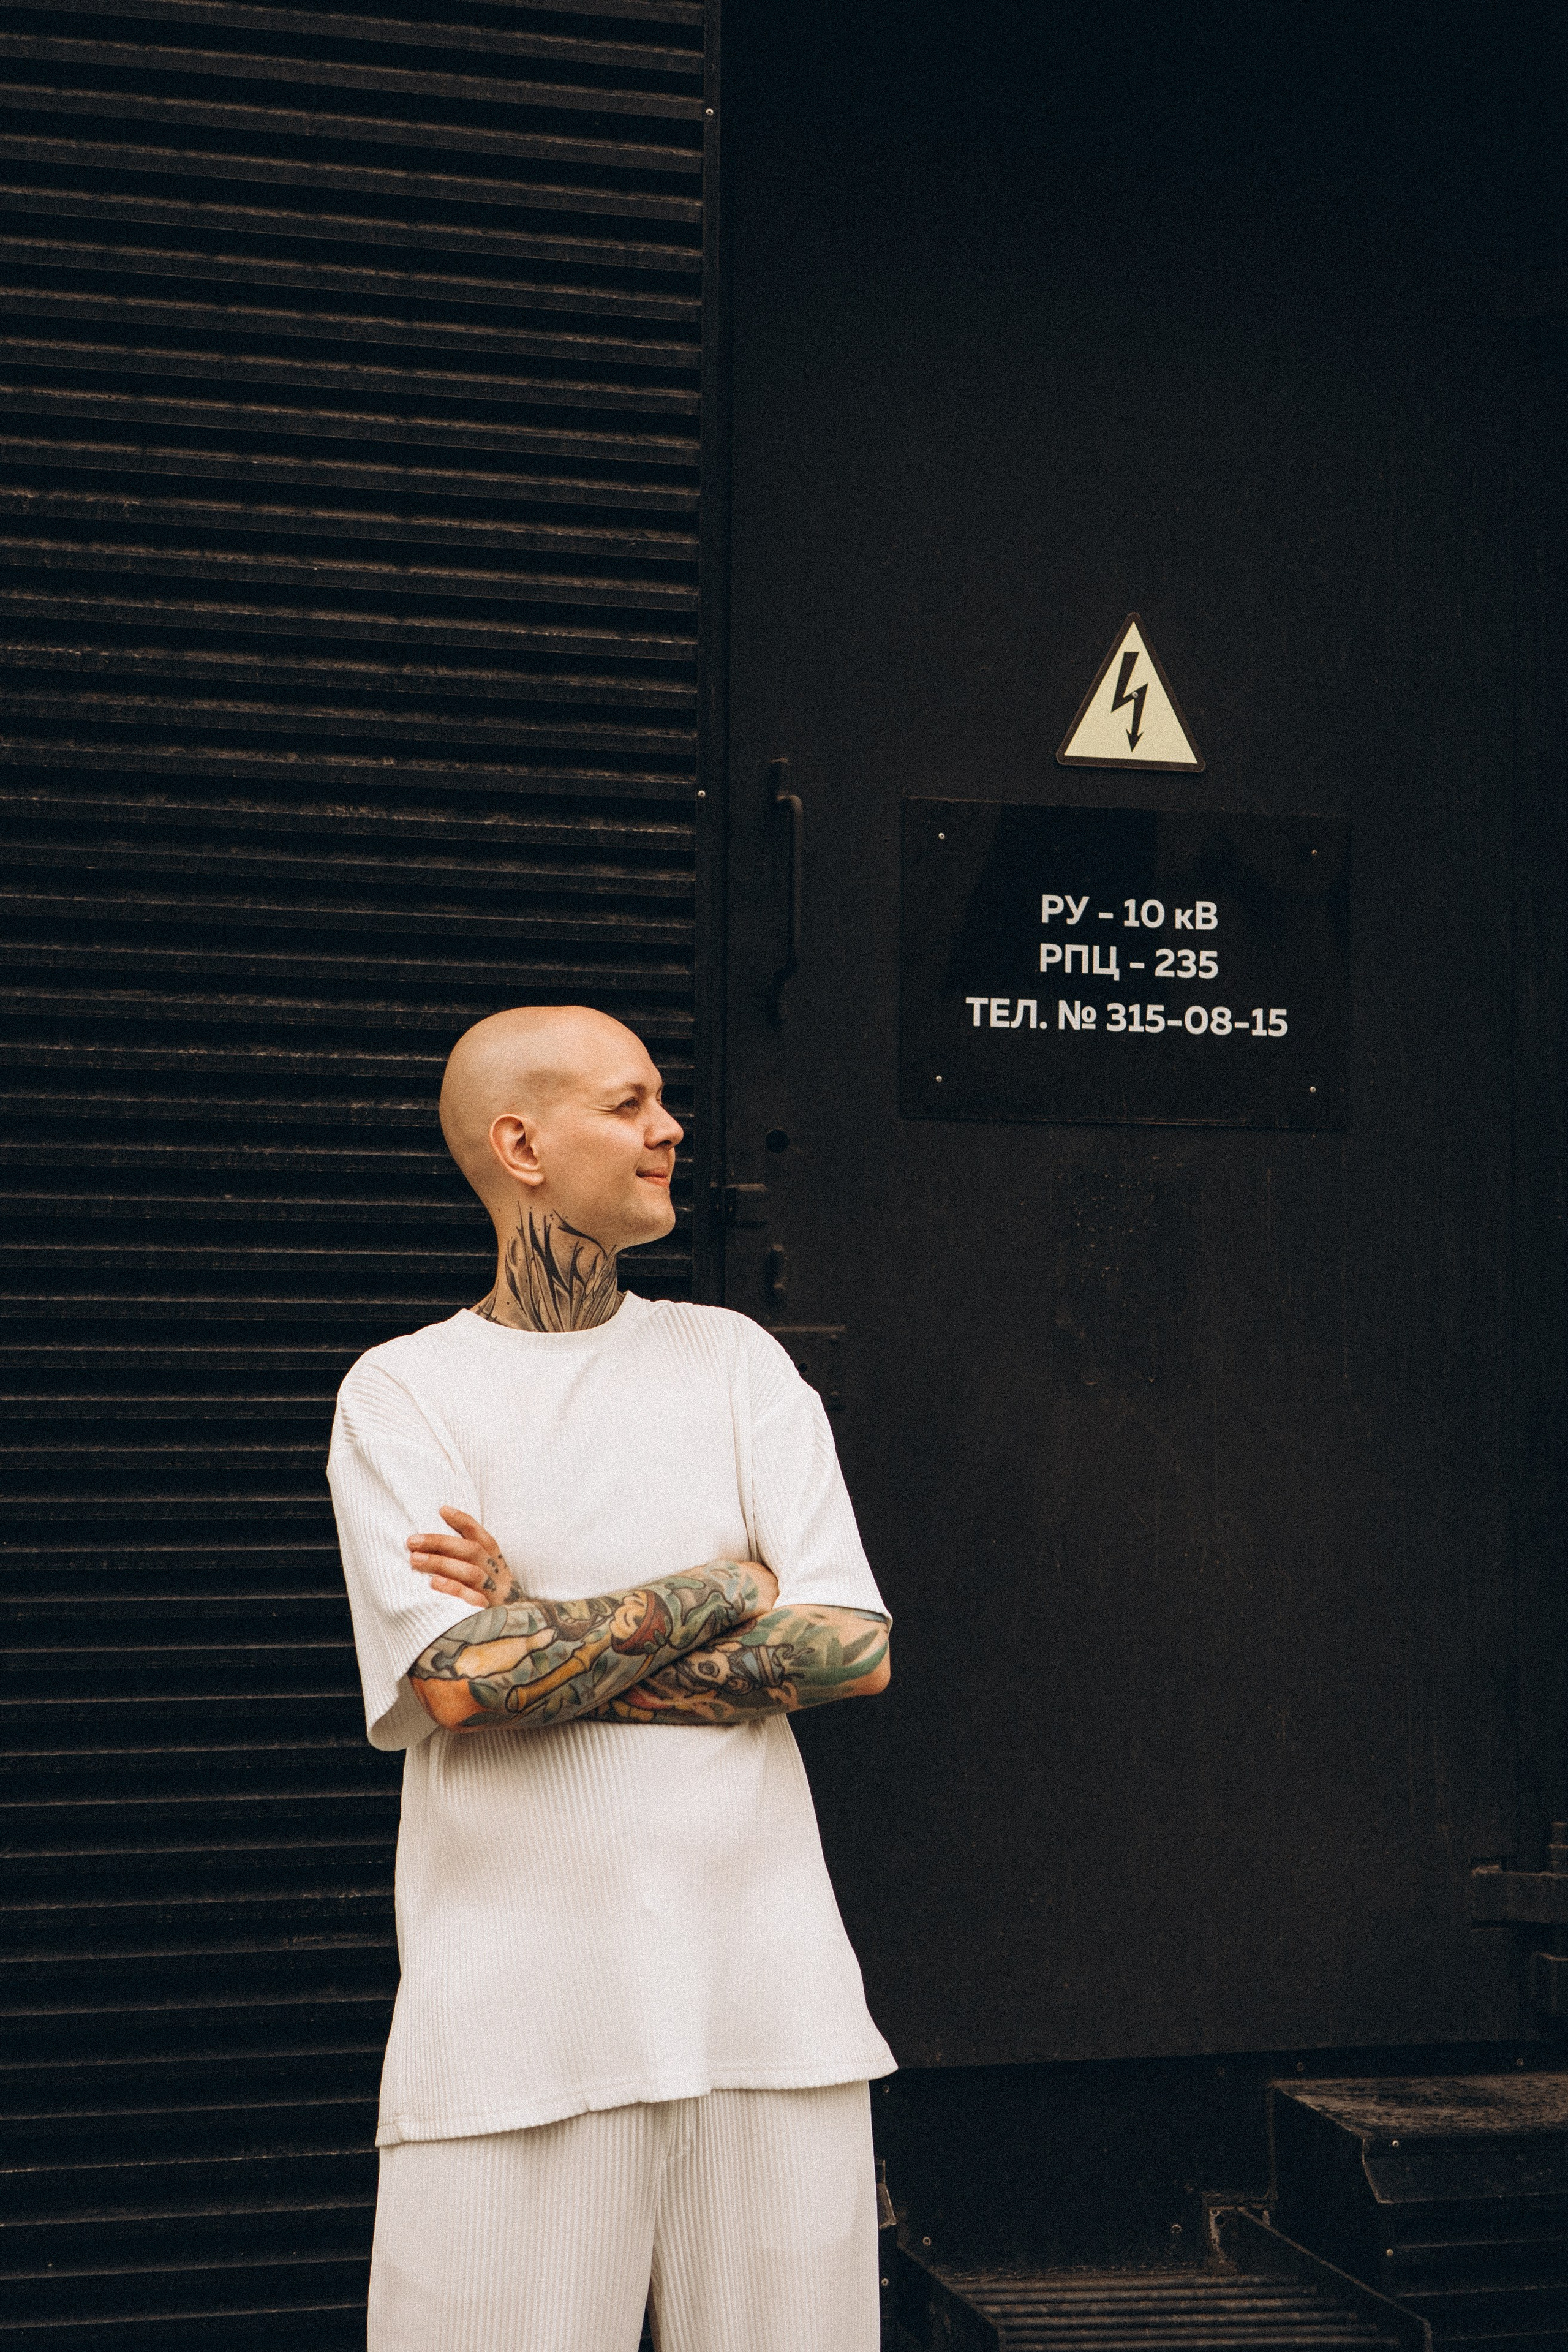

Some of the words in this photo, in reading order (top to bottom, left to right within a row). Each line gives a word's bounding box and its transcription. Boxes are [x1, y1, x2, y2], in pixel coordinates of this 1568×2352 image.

[1041, 894, 1090, 925] РУ
[1124, 899, 1165, 928] 10
[1175, 900, 1218, 930] кВ
[1039, 943, 1120, 981] РПЦ
[1155, 948, 1219, 979] 235
[965, 997, 1047, 1030] ТЕЛ.
[1058, 1000, 1097, 1030] №
[1106, 1003, 1288, 1037] 315-08-15
